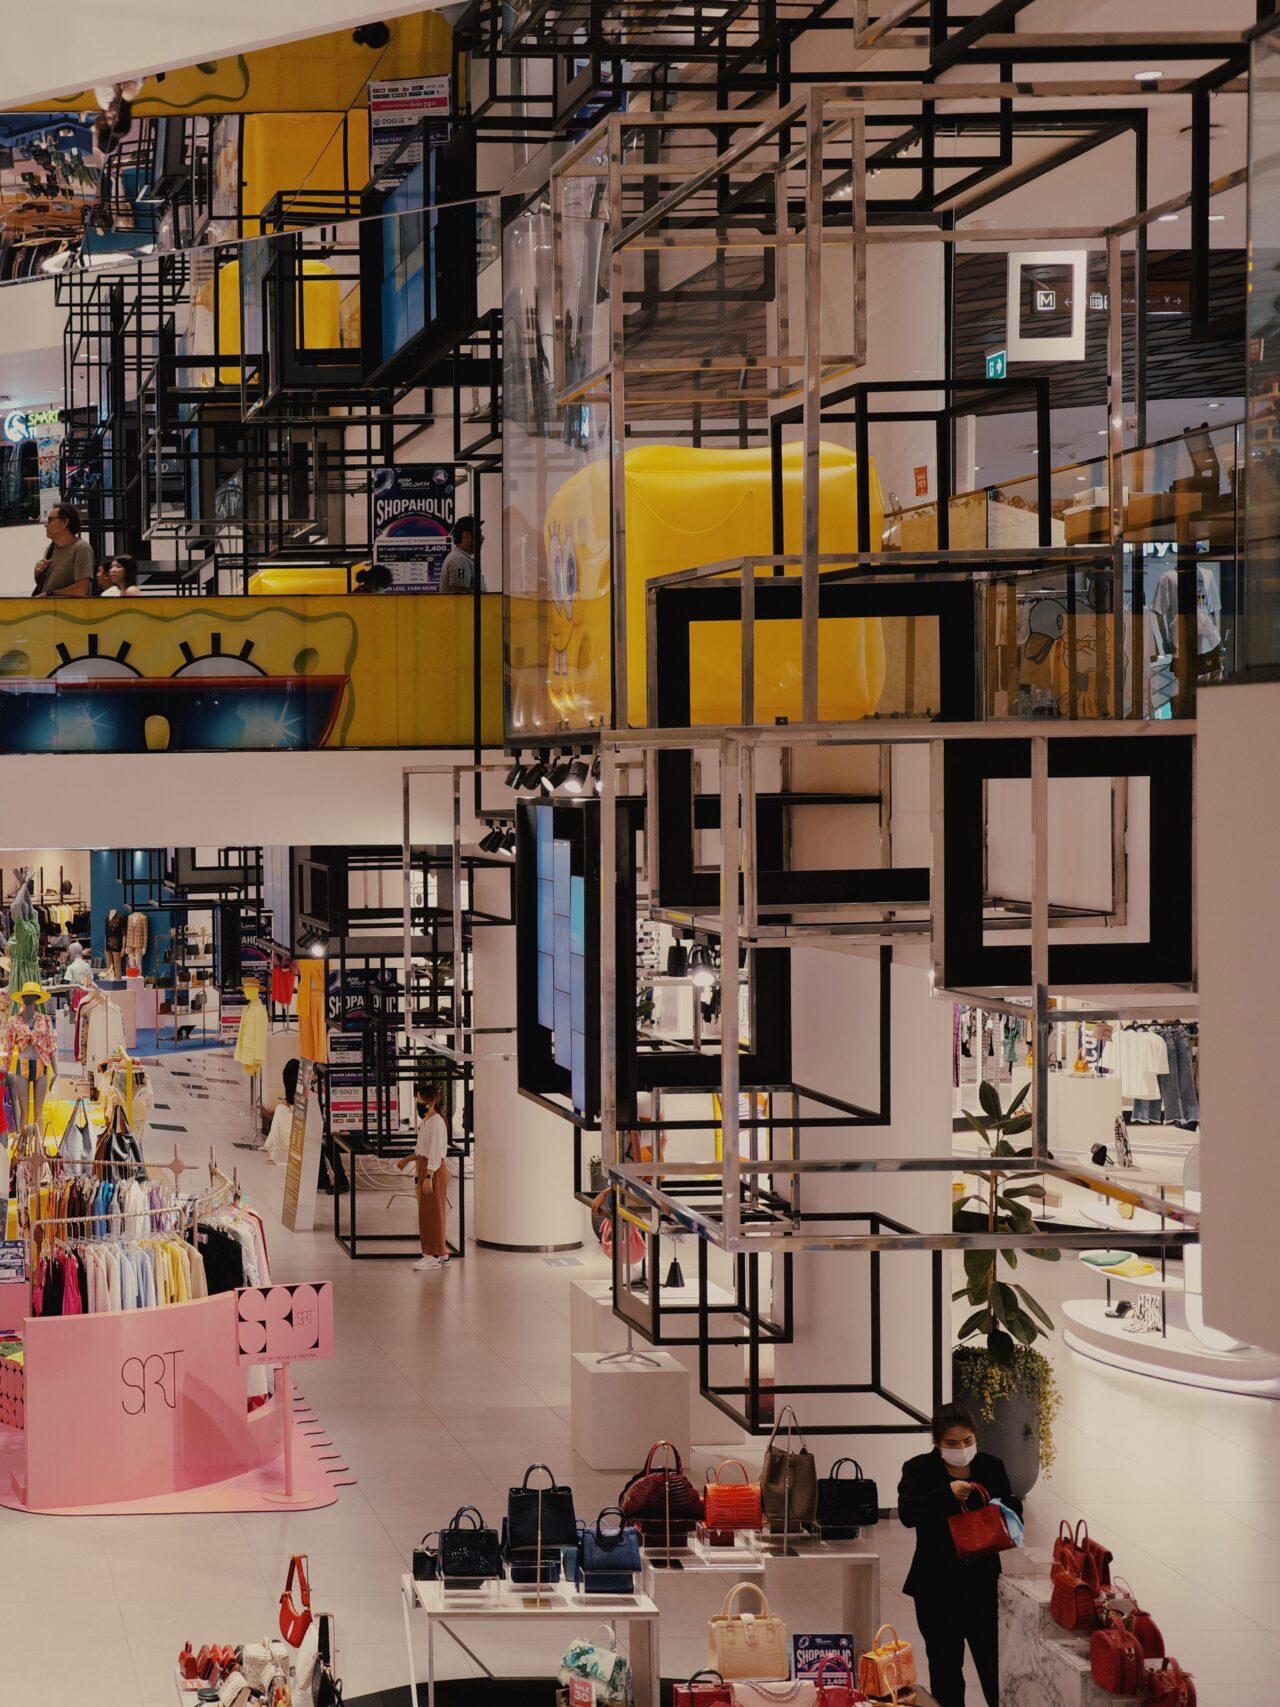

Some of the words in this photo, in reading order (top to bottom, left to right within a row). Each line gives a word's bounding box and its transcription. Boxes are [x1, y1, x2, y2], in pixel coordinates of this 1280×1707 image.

[27, 410, 61, 425] SMART
[376, 498, 453, 526] SHOPAHOLIC
[121, 1349, 185, 1416] SRT
